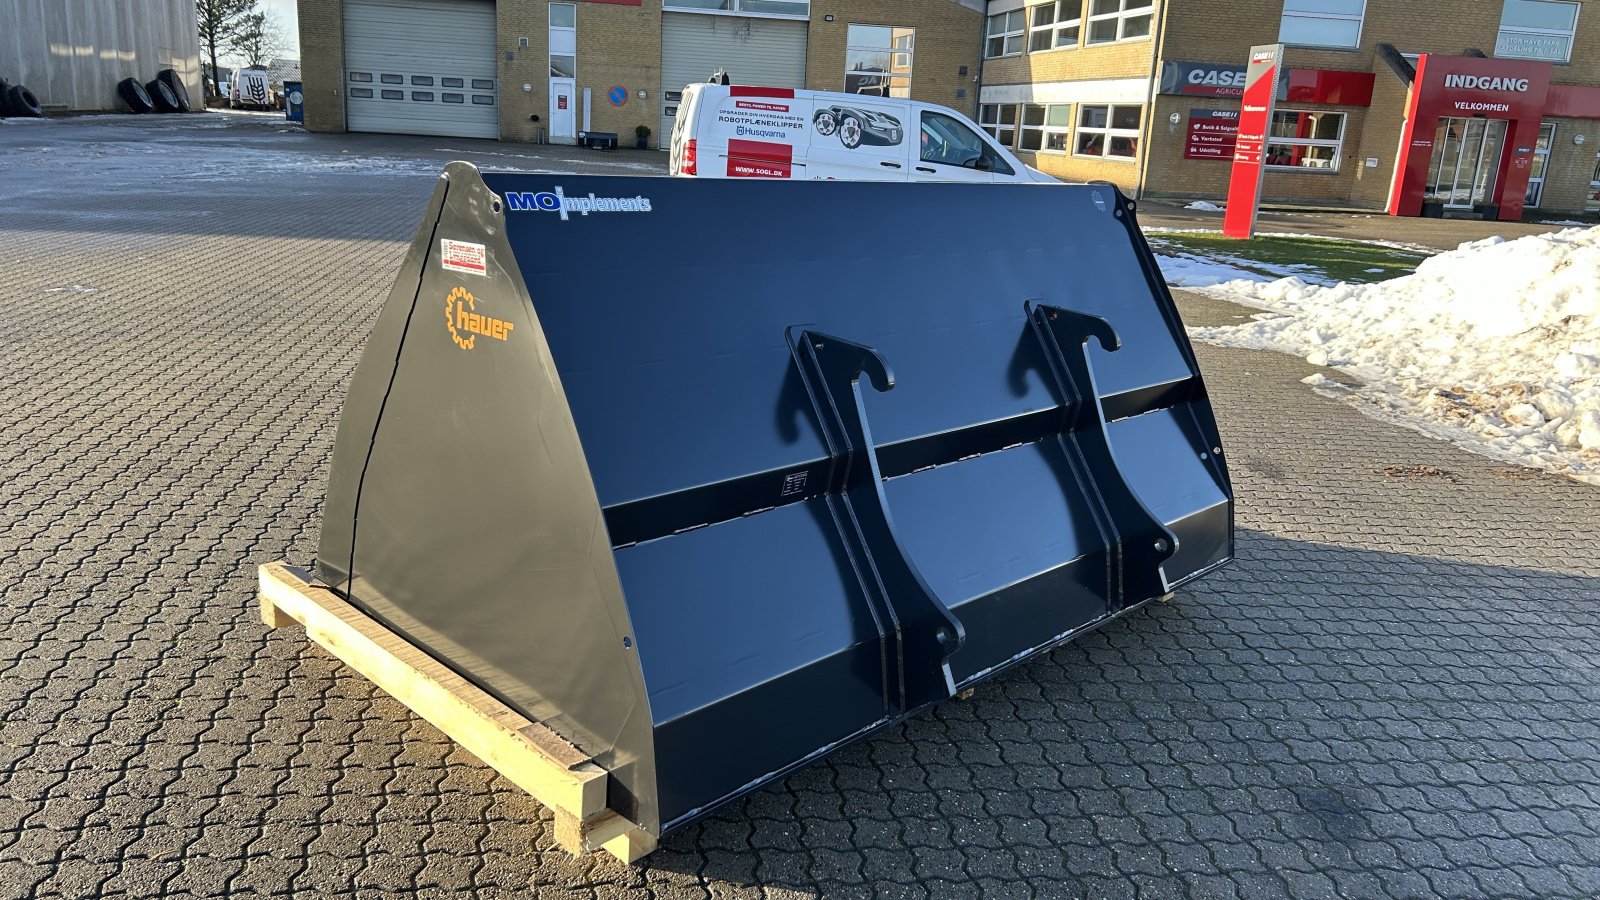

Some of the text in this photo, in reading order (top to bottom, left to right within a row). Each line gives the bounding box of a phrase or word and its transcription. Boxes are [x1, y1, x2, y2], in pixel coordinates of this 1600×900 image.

[1187, 69, 1246, 87] CASE
[1444, 74, 1529, 92] INDGANG
[1215, 87, 1244, 96] AGRICUL
[1454, 101, 1509, 112] VELKOMMEN
[718, 116, 803, 129] ROBOTPLÆNEKLIPPER
[745, 127, 786, 139] Husqvarna
[735, 166, 783, 177] WWW.SOGL.DK
[457, 300, 514, 341] hauer
